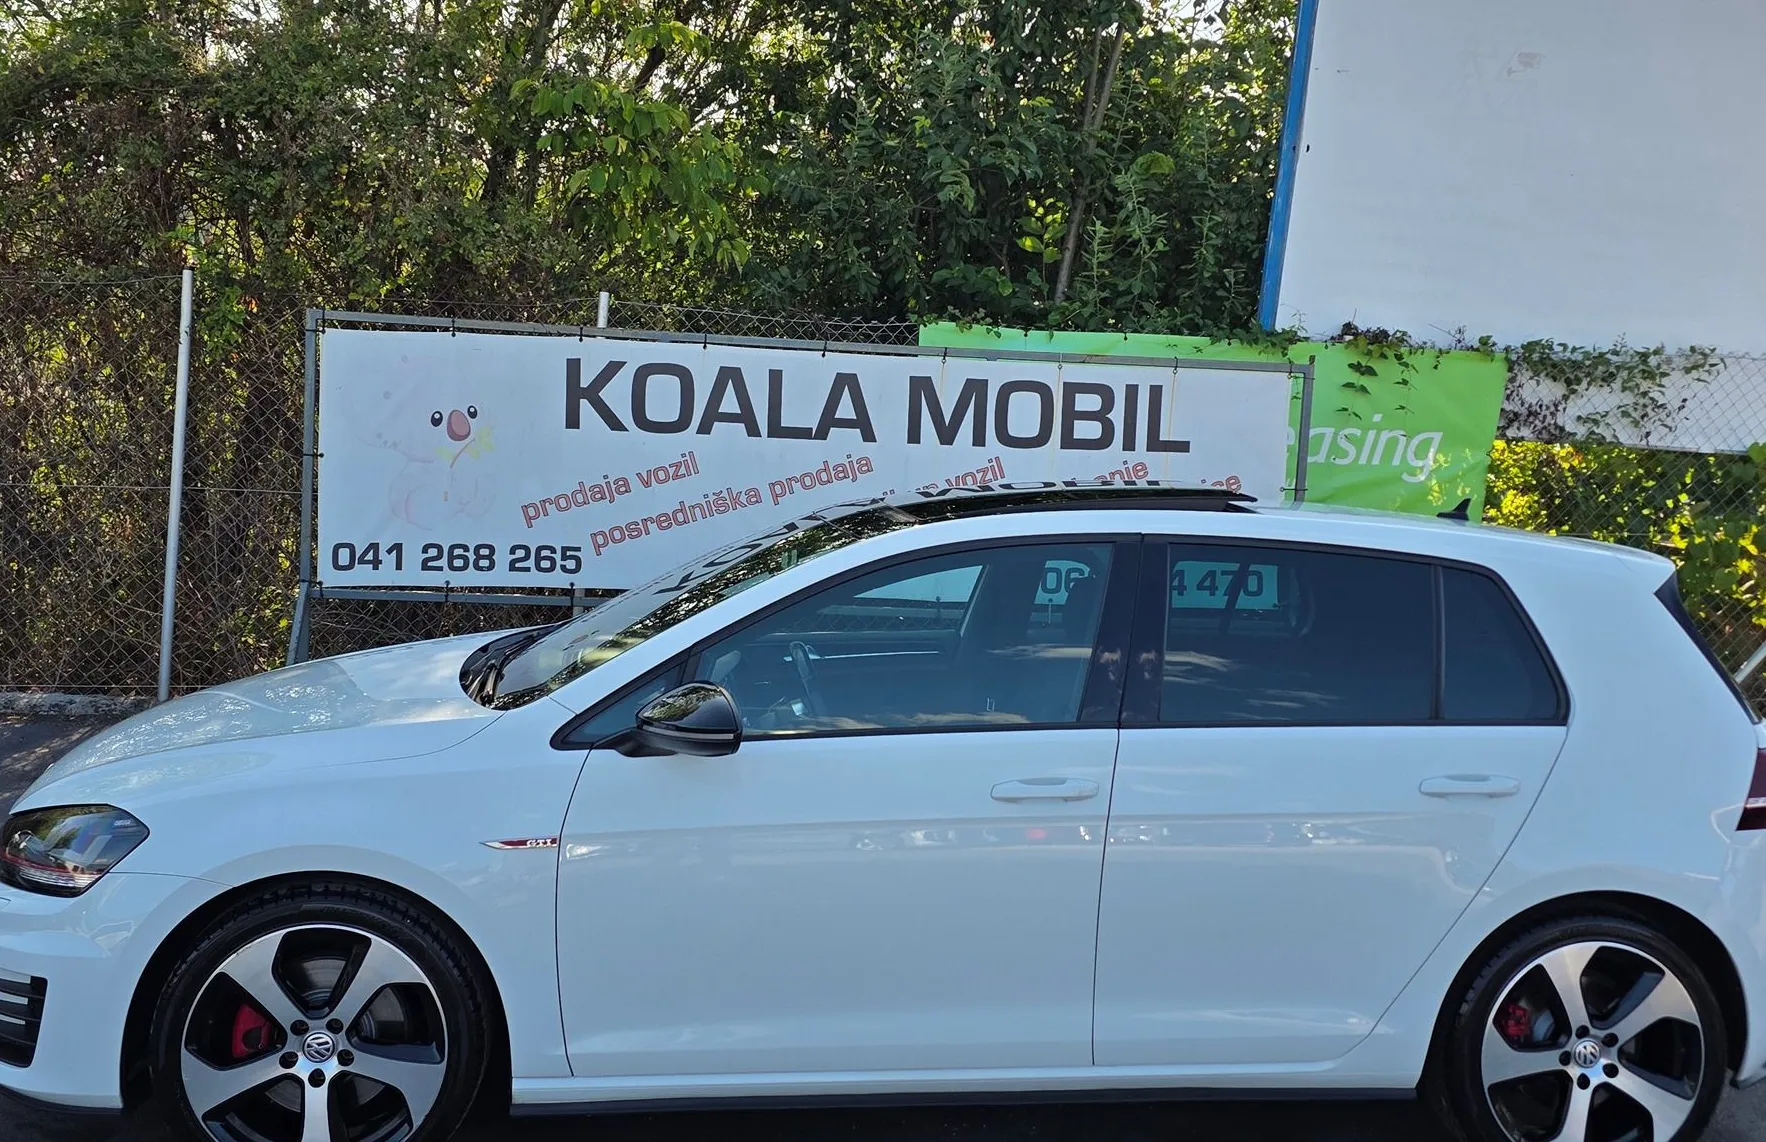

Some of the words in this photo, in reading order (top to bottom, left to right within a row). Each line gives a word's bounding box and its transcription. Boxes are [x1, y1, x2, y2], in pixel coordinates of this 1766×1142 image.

[565, 357, 878, 443] KOALA
[906, 375, 1191, 454] MOBIL
[520, 474, 632, 529] prodaja
[635, 450, 701, 489] vozil
[589, 487, 763, 557] posredniška
[768, 453, 874, 506] prodaja
[332, 542, 404, 572] 041
[420, 542, 496, 572] 268
[508, 543, 583, 575] 265
[526, 838, 552, 848] GTI
